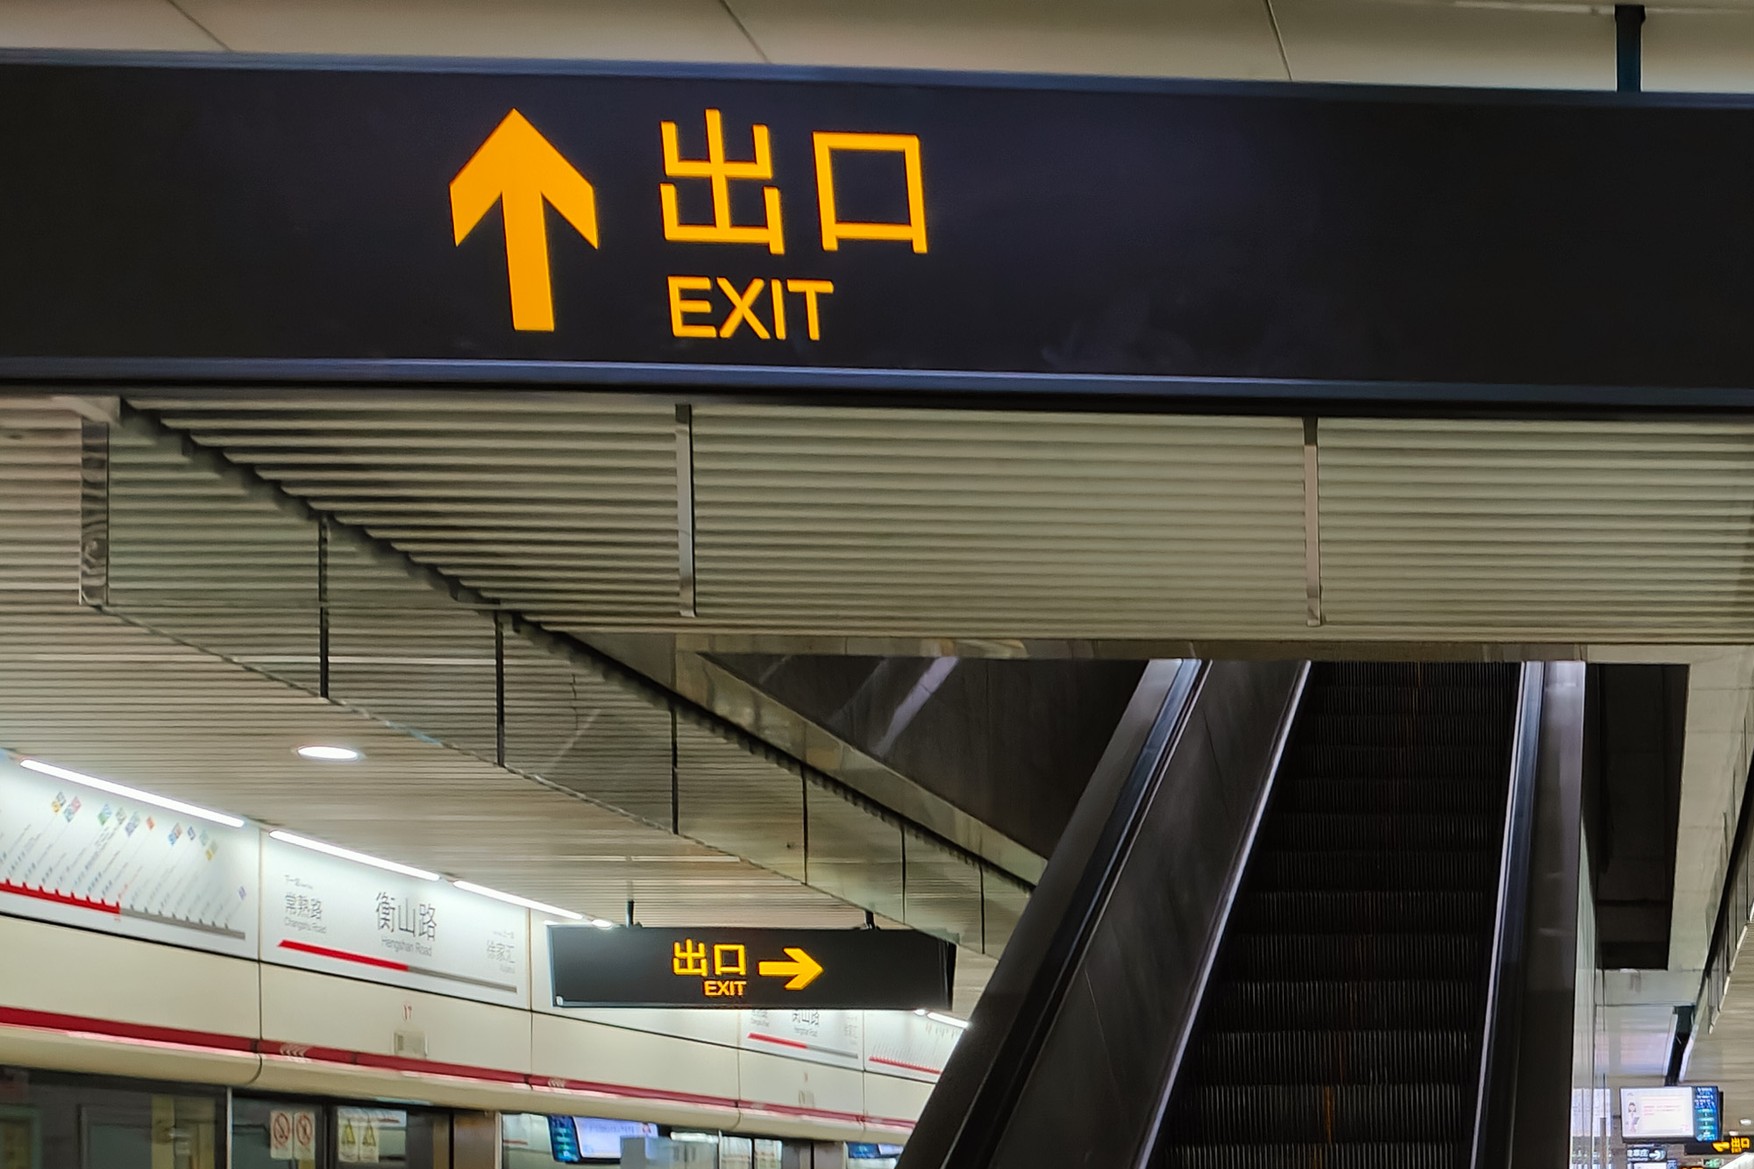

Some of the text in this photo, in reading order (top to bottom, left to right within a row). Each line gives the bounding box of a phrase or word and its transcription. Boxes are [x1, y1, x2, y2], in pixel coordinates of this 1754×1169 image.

[660, 108, 928, 254] 出口
[668, 275, 834, 340] EXIT
[376, 892, 437, 941] 衡山路
[673, 938, 747, 977] 出口
[704, 980, 747, 997] EXIT
[1731, 1137, 1750, 1149] 出口
